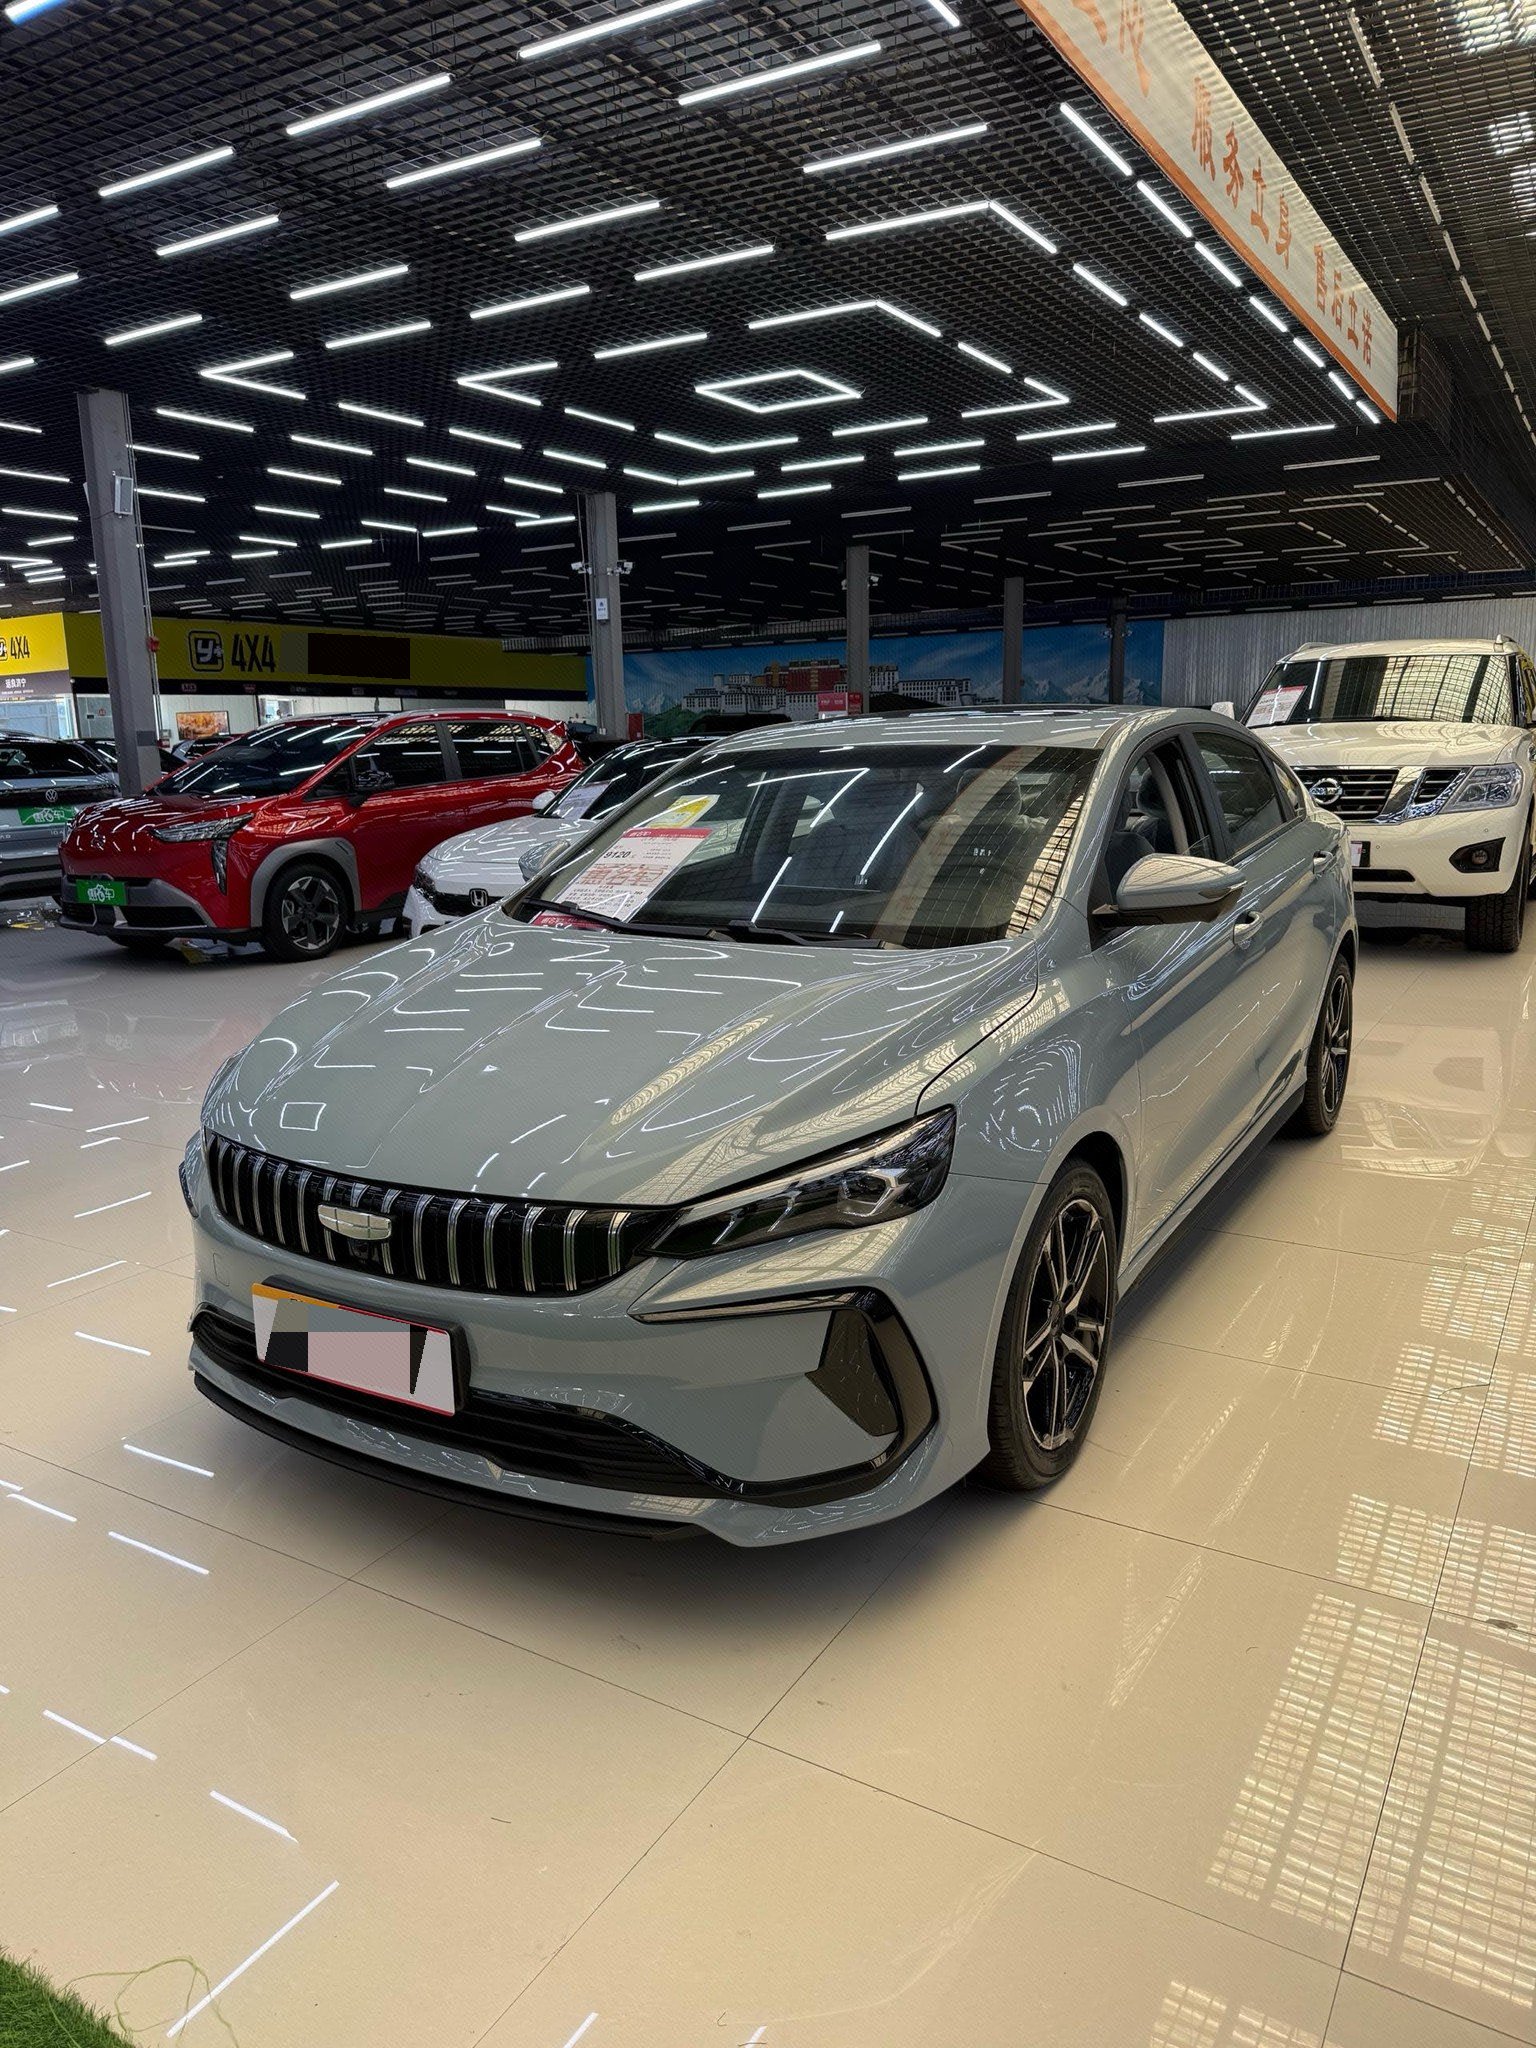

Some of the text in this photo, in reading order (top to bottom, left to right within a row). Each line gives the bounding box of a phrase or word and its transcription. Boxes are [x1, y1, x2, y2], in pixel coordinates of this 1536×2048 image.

[1190, 77, 1294, 269] 服务立身
[10, 635, 30, 659] 4X4
[231, 633, 276, 672] 4X4
